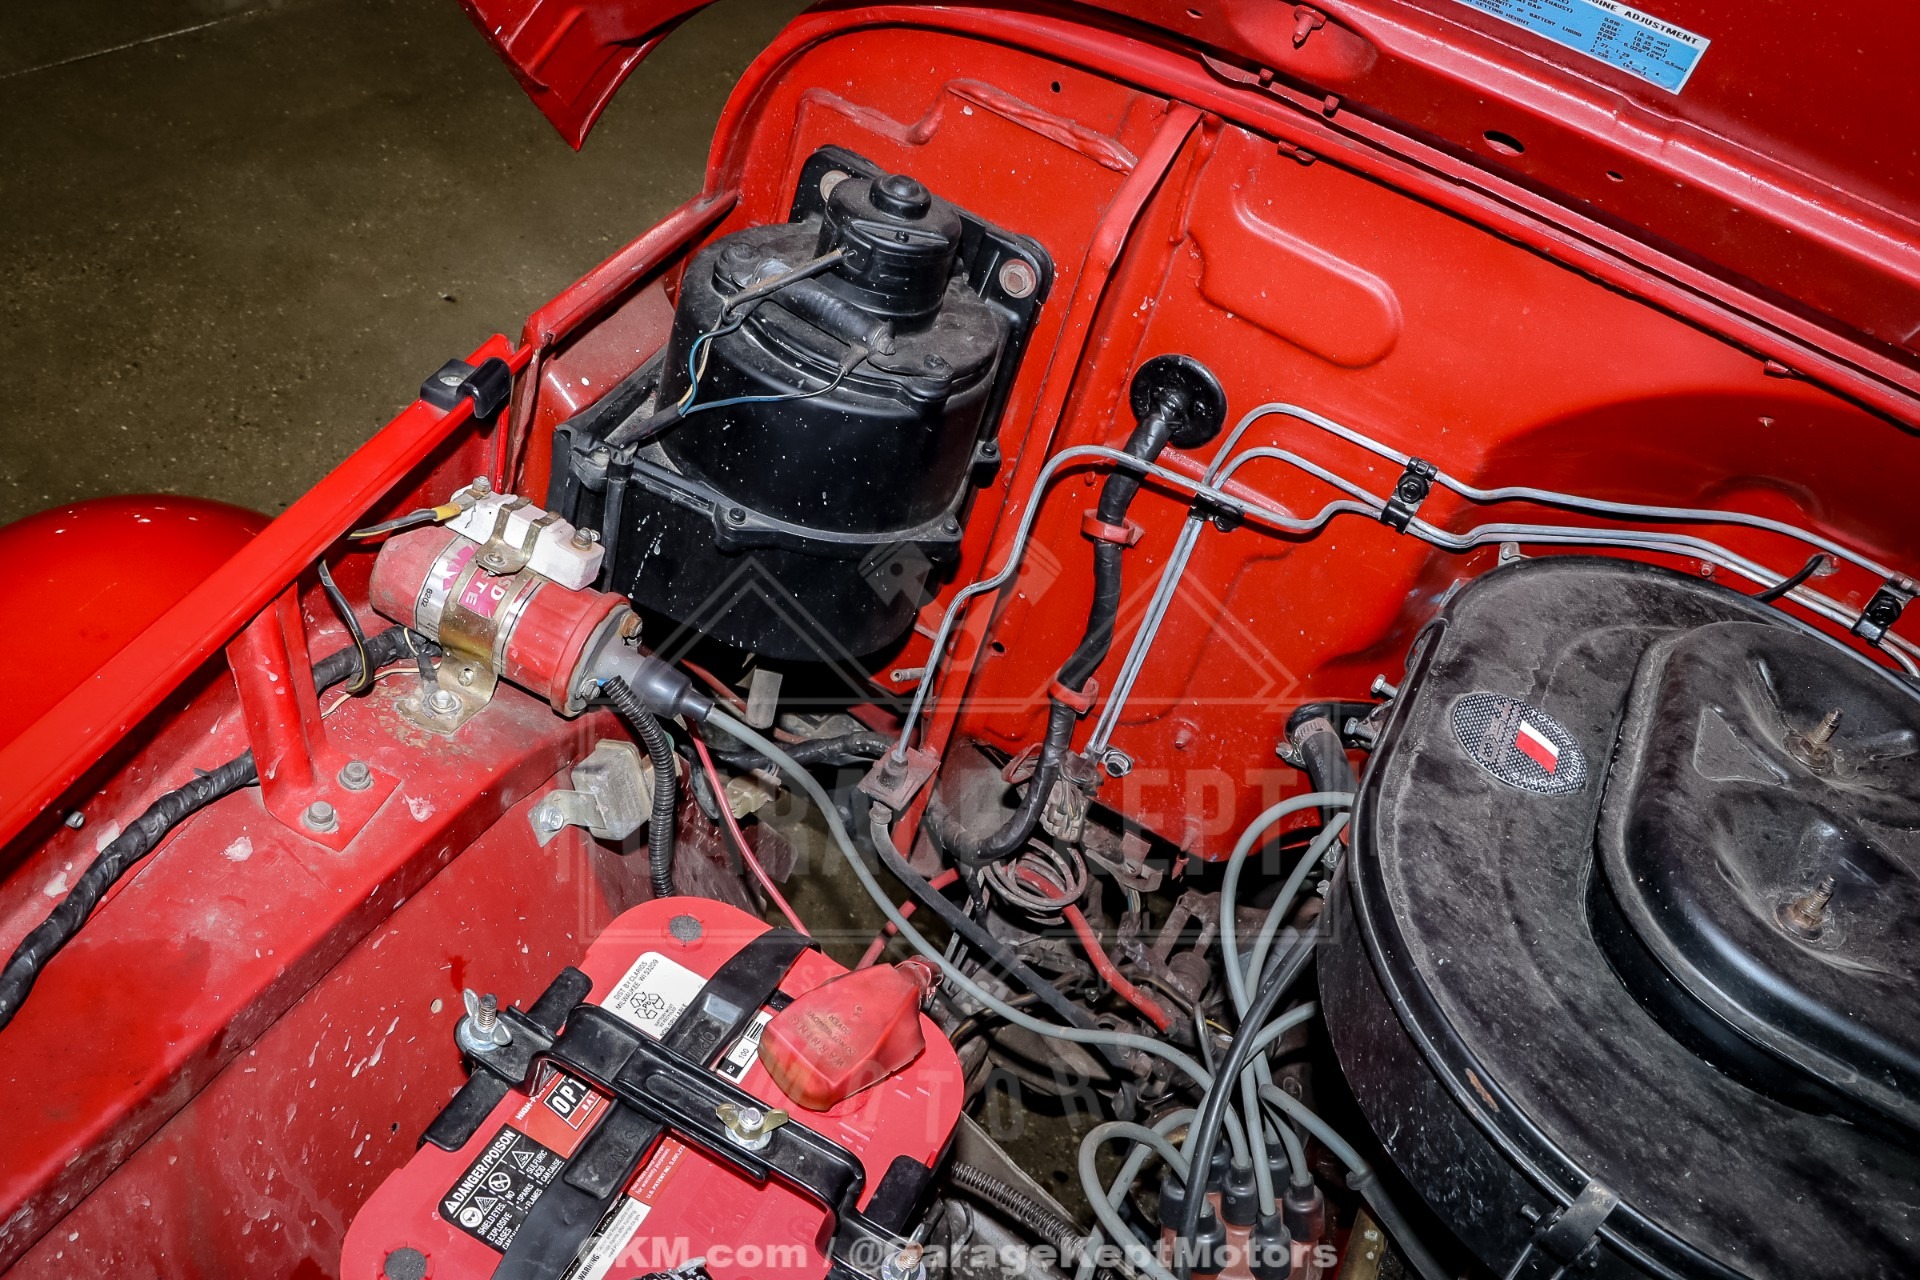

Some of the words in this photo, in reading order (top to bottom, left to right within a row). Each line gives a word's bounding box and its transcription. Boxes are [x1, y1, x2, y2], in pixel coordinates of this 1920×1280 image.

[1623, 9, 1700, 46] ADJUSTMENT
[1530, 709, 1573, 747] TOYOTA
[1562, 751, 1581, 784] MOTOR
[1510, 771, 1563, 788] SPORTS
[641, 998, 653, 1010] Pb
[789, 1014, 845, 1068] WARNING
[737, 1046, 750, 1060] 100
[725, 1063, 736, 1075] RC
[452, 1128, 517, 1204] DANGER/POISON
[525, 1148, 549, 1175] SULFURIC
[532, 1164, 547, 1179] ACID
[504, 1189, 516, 1201] NO
[516, 1182, 535, 1203] SPARKS
[525, 1187, 544, 1208] FLAMES
[477, 1214, 497, 1237] SHIELD
[486, 1211, 513, 1243] EXPLOSIVE
[494, 1225, 513, 1247] GASES
[576, 1251, 602, 1280] WARNING:
